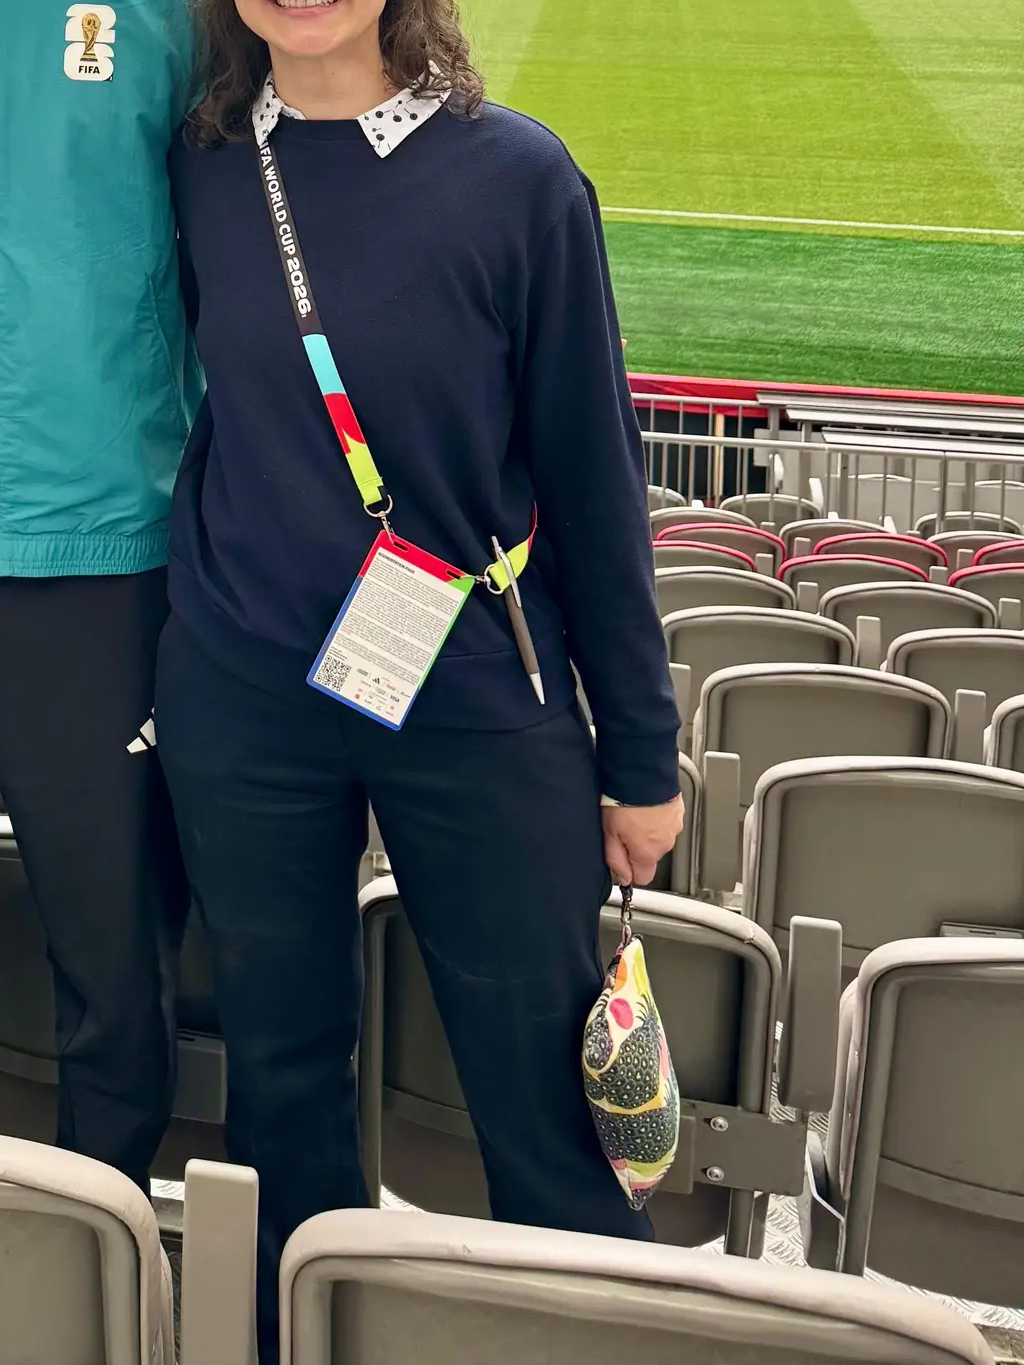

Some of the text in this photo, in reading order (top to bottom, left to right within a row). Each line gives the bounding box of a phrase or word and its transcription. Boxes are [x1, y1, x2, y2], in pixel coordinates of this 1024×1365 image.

[78, 65, 101, 75] FIFA
[259, 141, 312, 316] IFA WORLD CUP 2026
